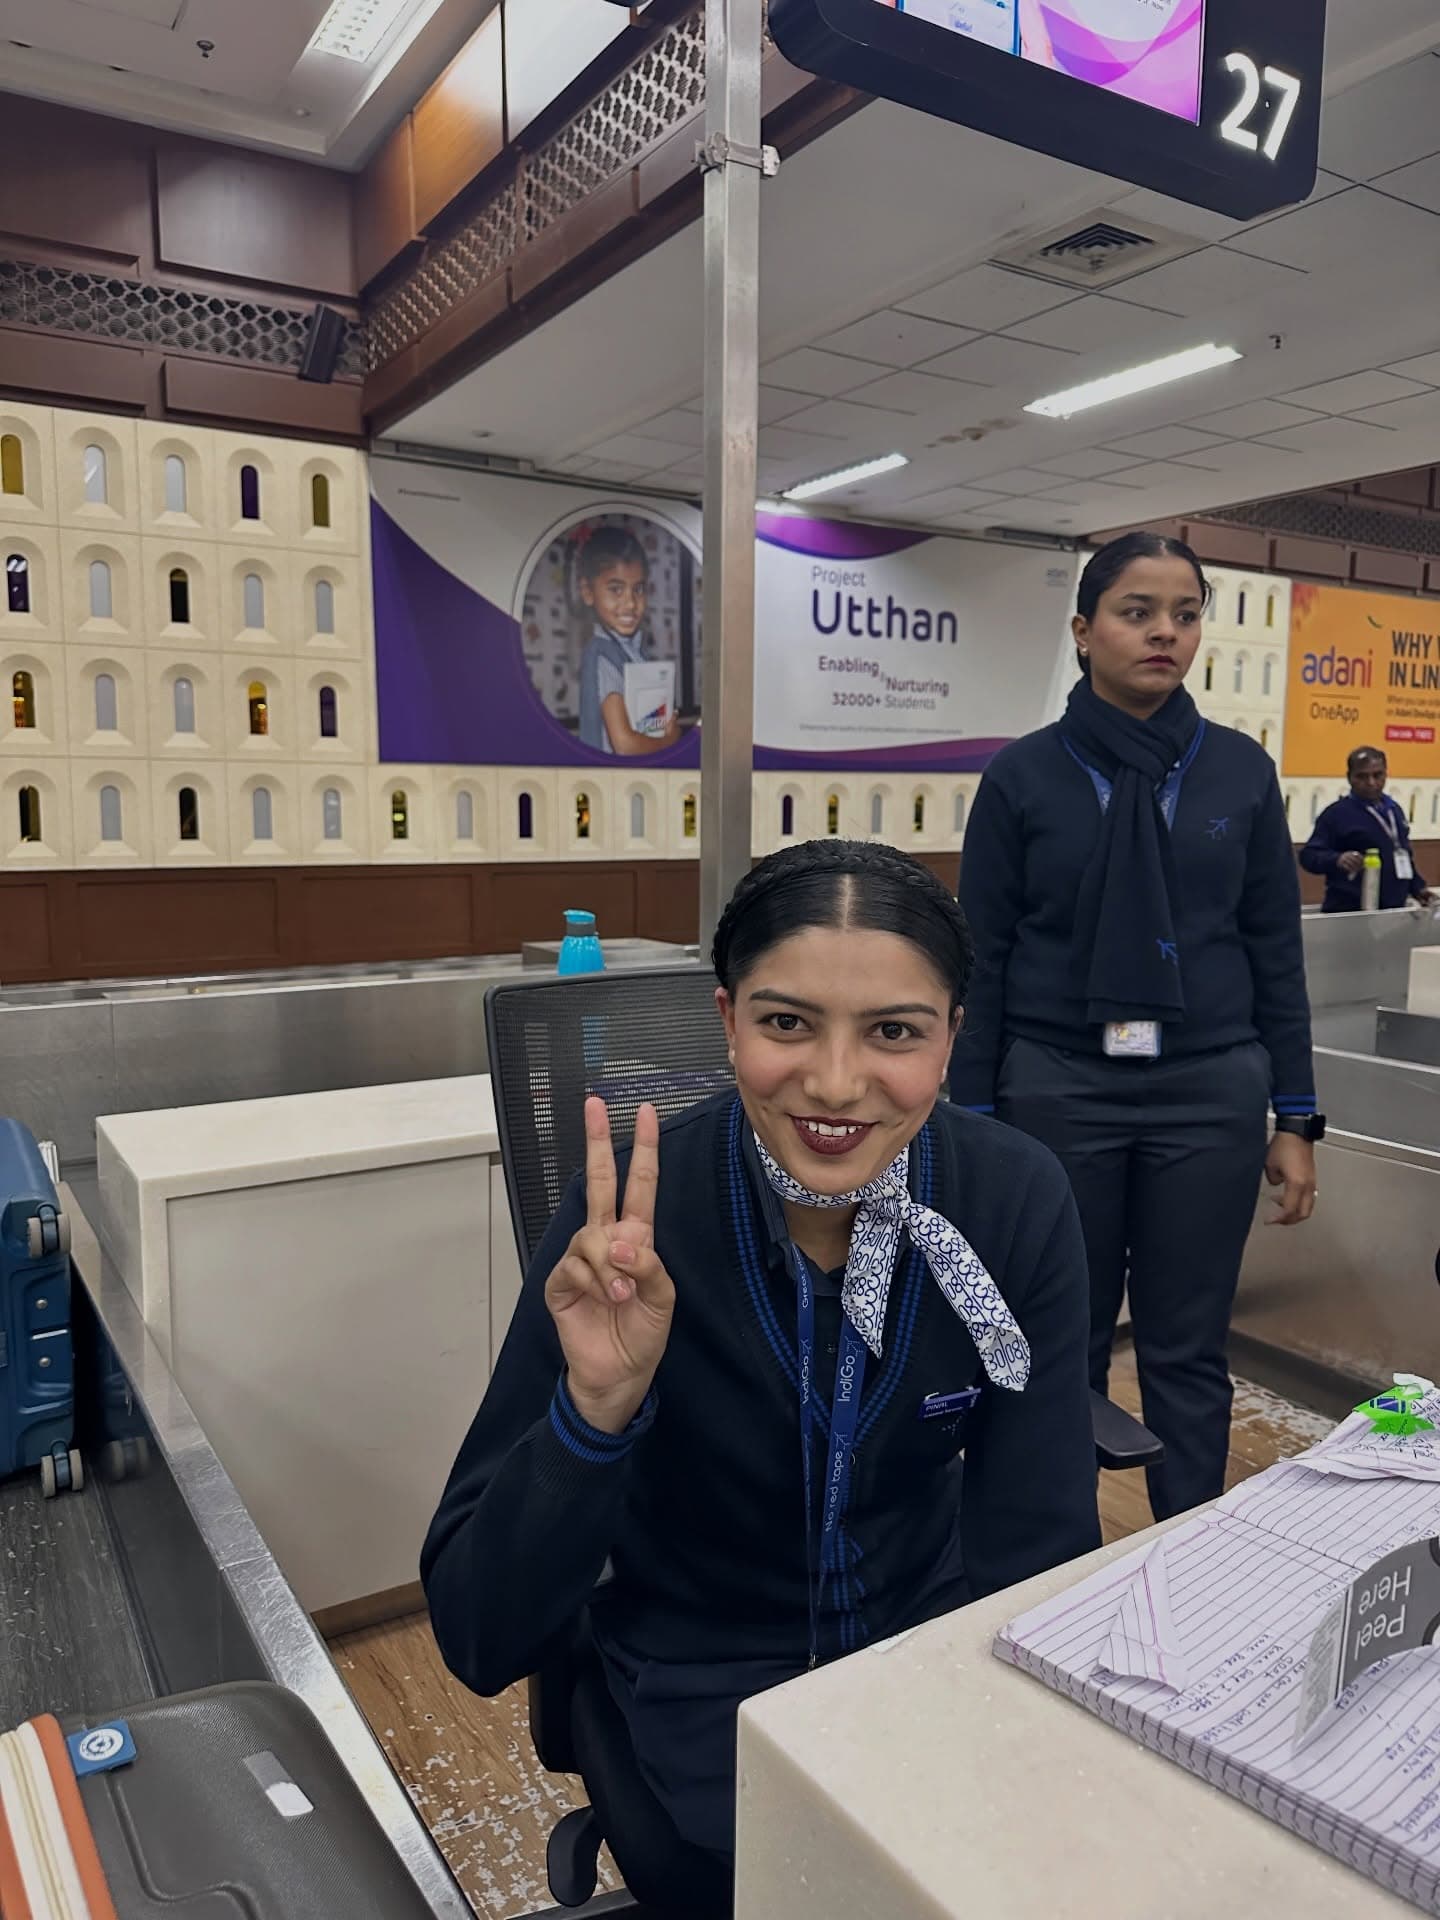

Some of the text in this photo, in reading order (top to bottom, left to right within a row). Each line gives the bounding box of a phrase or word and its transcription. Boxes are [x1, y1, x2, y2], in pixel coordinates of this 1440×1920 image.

[1221, 52, 1300, 160] 27
[811, 565, 867, 588] Project
[812, 589, 958, 643] Utthan
[1392, 630, 1433, 660] WHY
[1302, 645, 1373, 688] adani
[1389, 661, 1407, 687] IN
[832, 692, 882, 708] 32000+
[885, 677, 950, 698] Nurturing
[1310, 702, 1359, 724] OneApp
[837, 1355, 856, 1402] IndiGo
[832, 1450, 845, 1482] tape
[829, 1486, 839, 1508] red
[1358, 1566, 1411, 1615] Here
[1355, 1604, 1406, 1661] Peel
